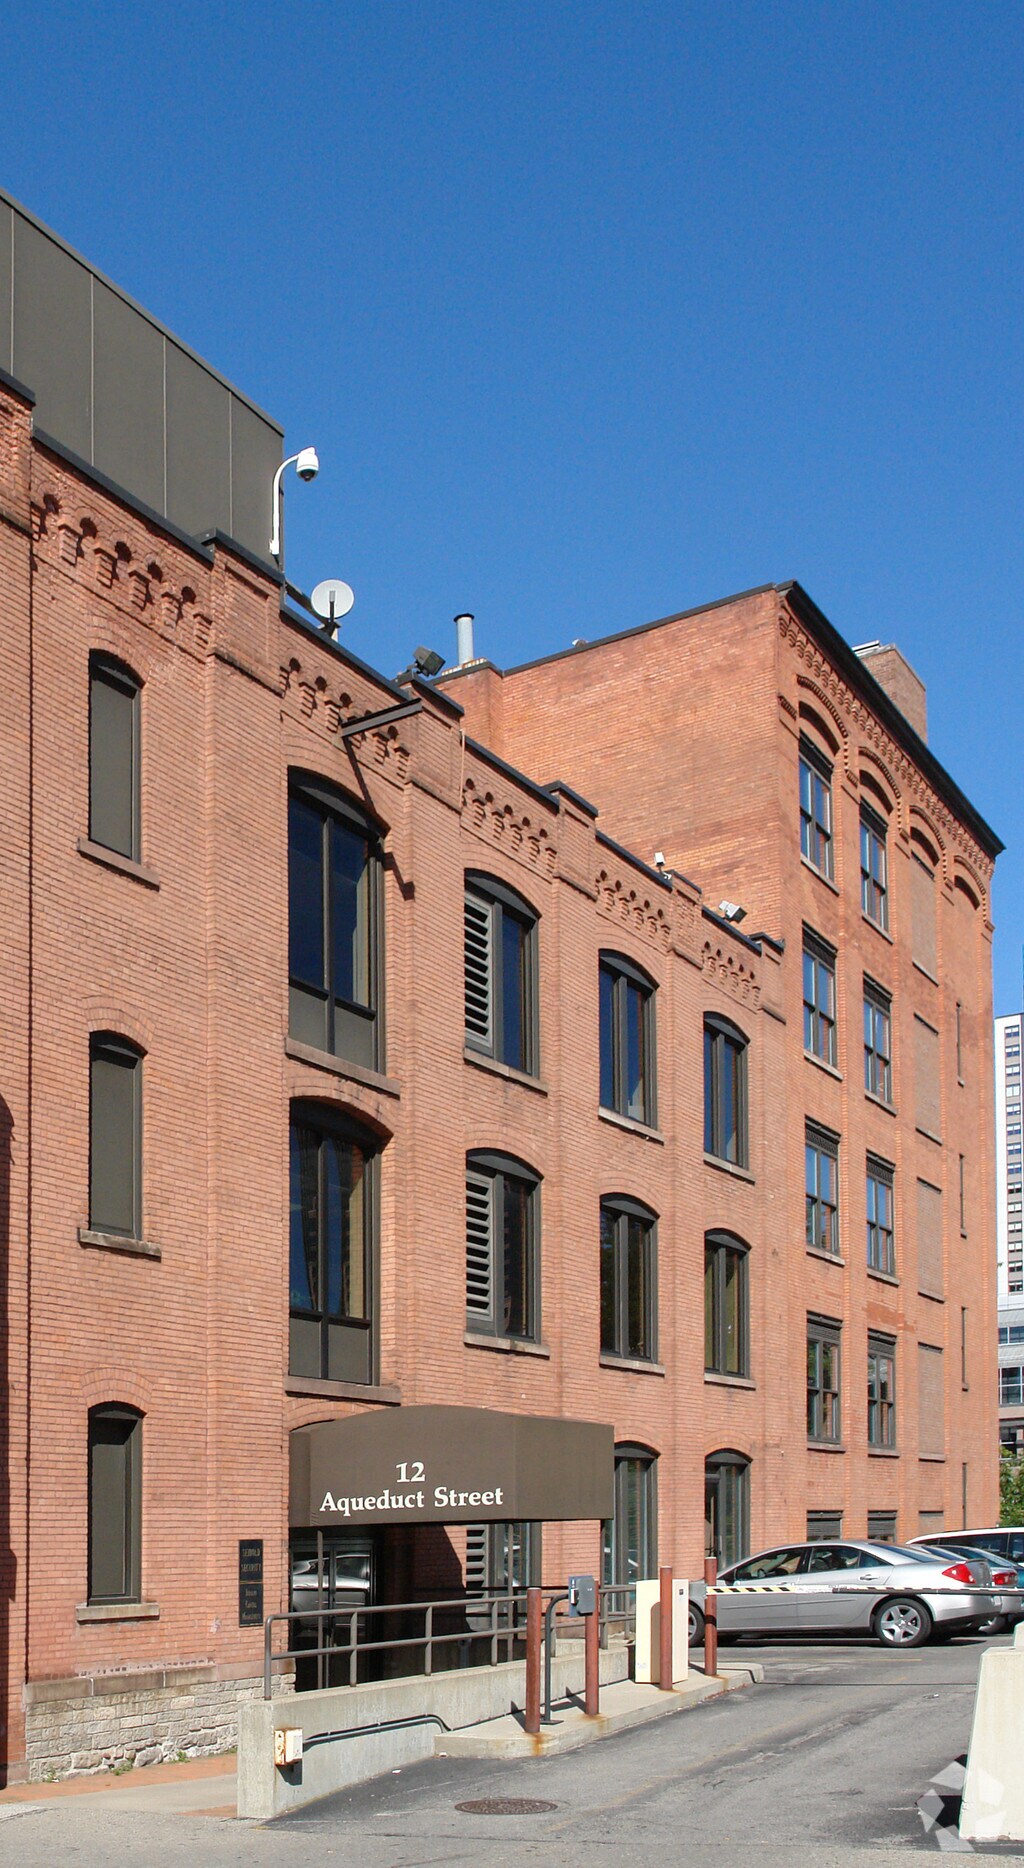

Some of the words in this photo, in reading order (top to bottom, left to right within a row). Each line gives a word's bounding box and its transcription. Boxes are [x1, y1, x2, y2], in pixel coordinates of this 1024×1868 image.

[396, 1461, 426, 1483] 12
[319, 1489, 425, 1517] Aqueduct
[434, 1486, 504, 1508] Street
